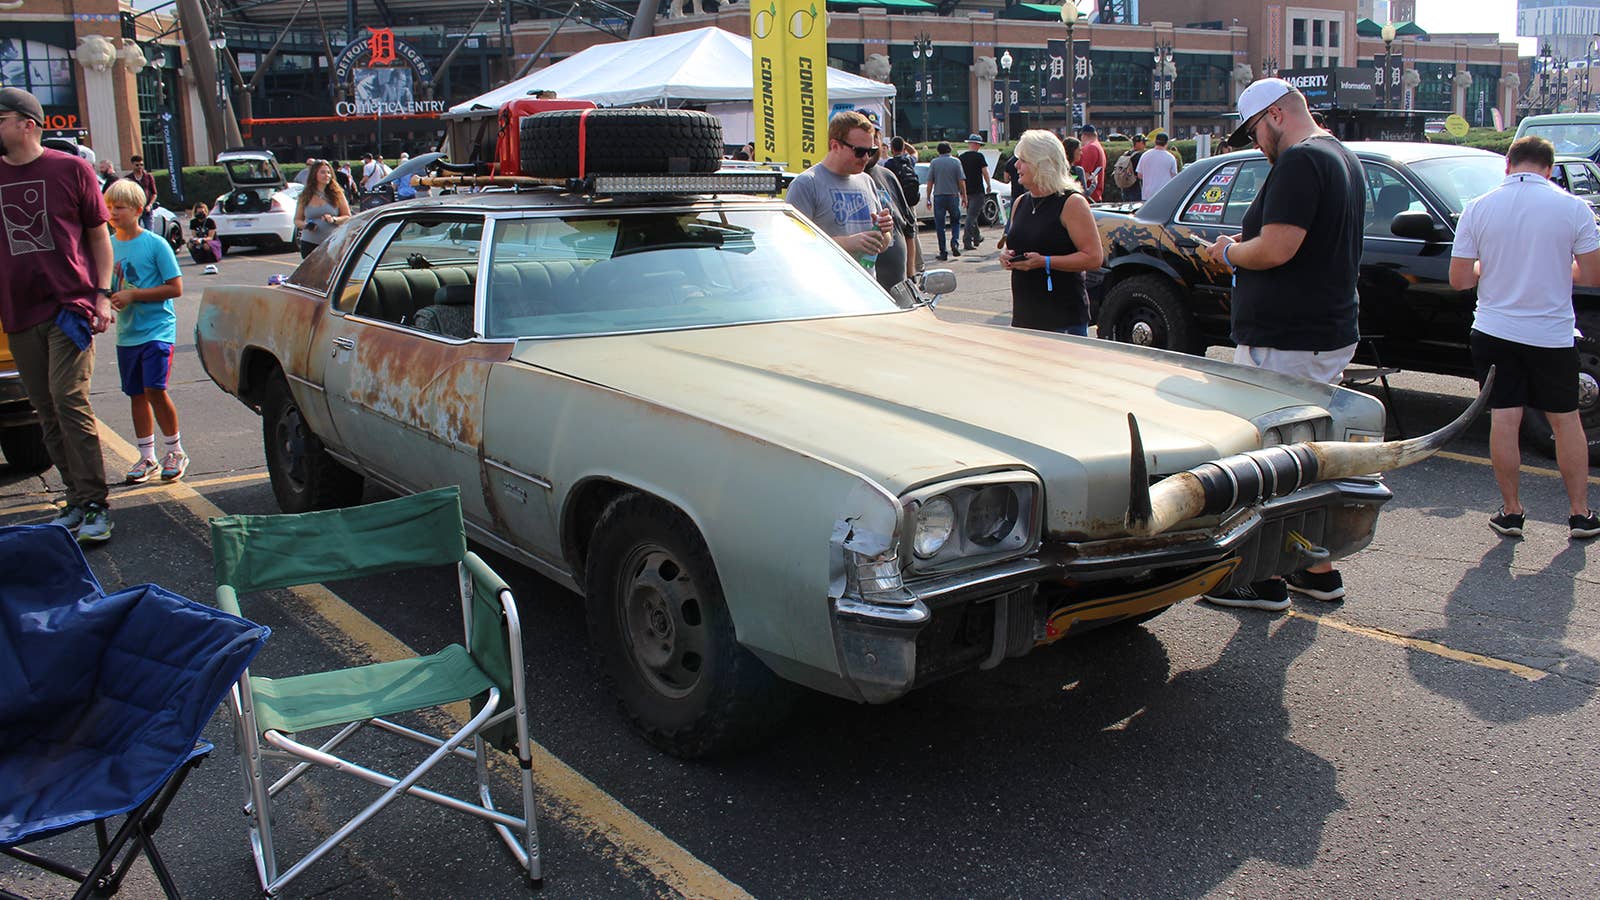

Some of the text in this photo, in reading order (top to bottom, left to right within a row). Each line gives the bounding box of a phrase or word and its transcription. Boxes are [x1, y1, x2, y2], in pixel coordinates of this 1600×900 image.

[336, 40, 429, 77] DETROIT TIGERS
[1340, 81, 1372, 90] Information
[407, 100, 446, 113] ENTRY
[760, 56, 775, 154] CONCOURS
[798, 56, 816, 155] CONCOURS
[43, 114, 77, 129] HOP
[1211, 174, 1232, 184] NX
[1188, 204, 1223, 214] ARP
